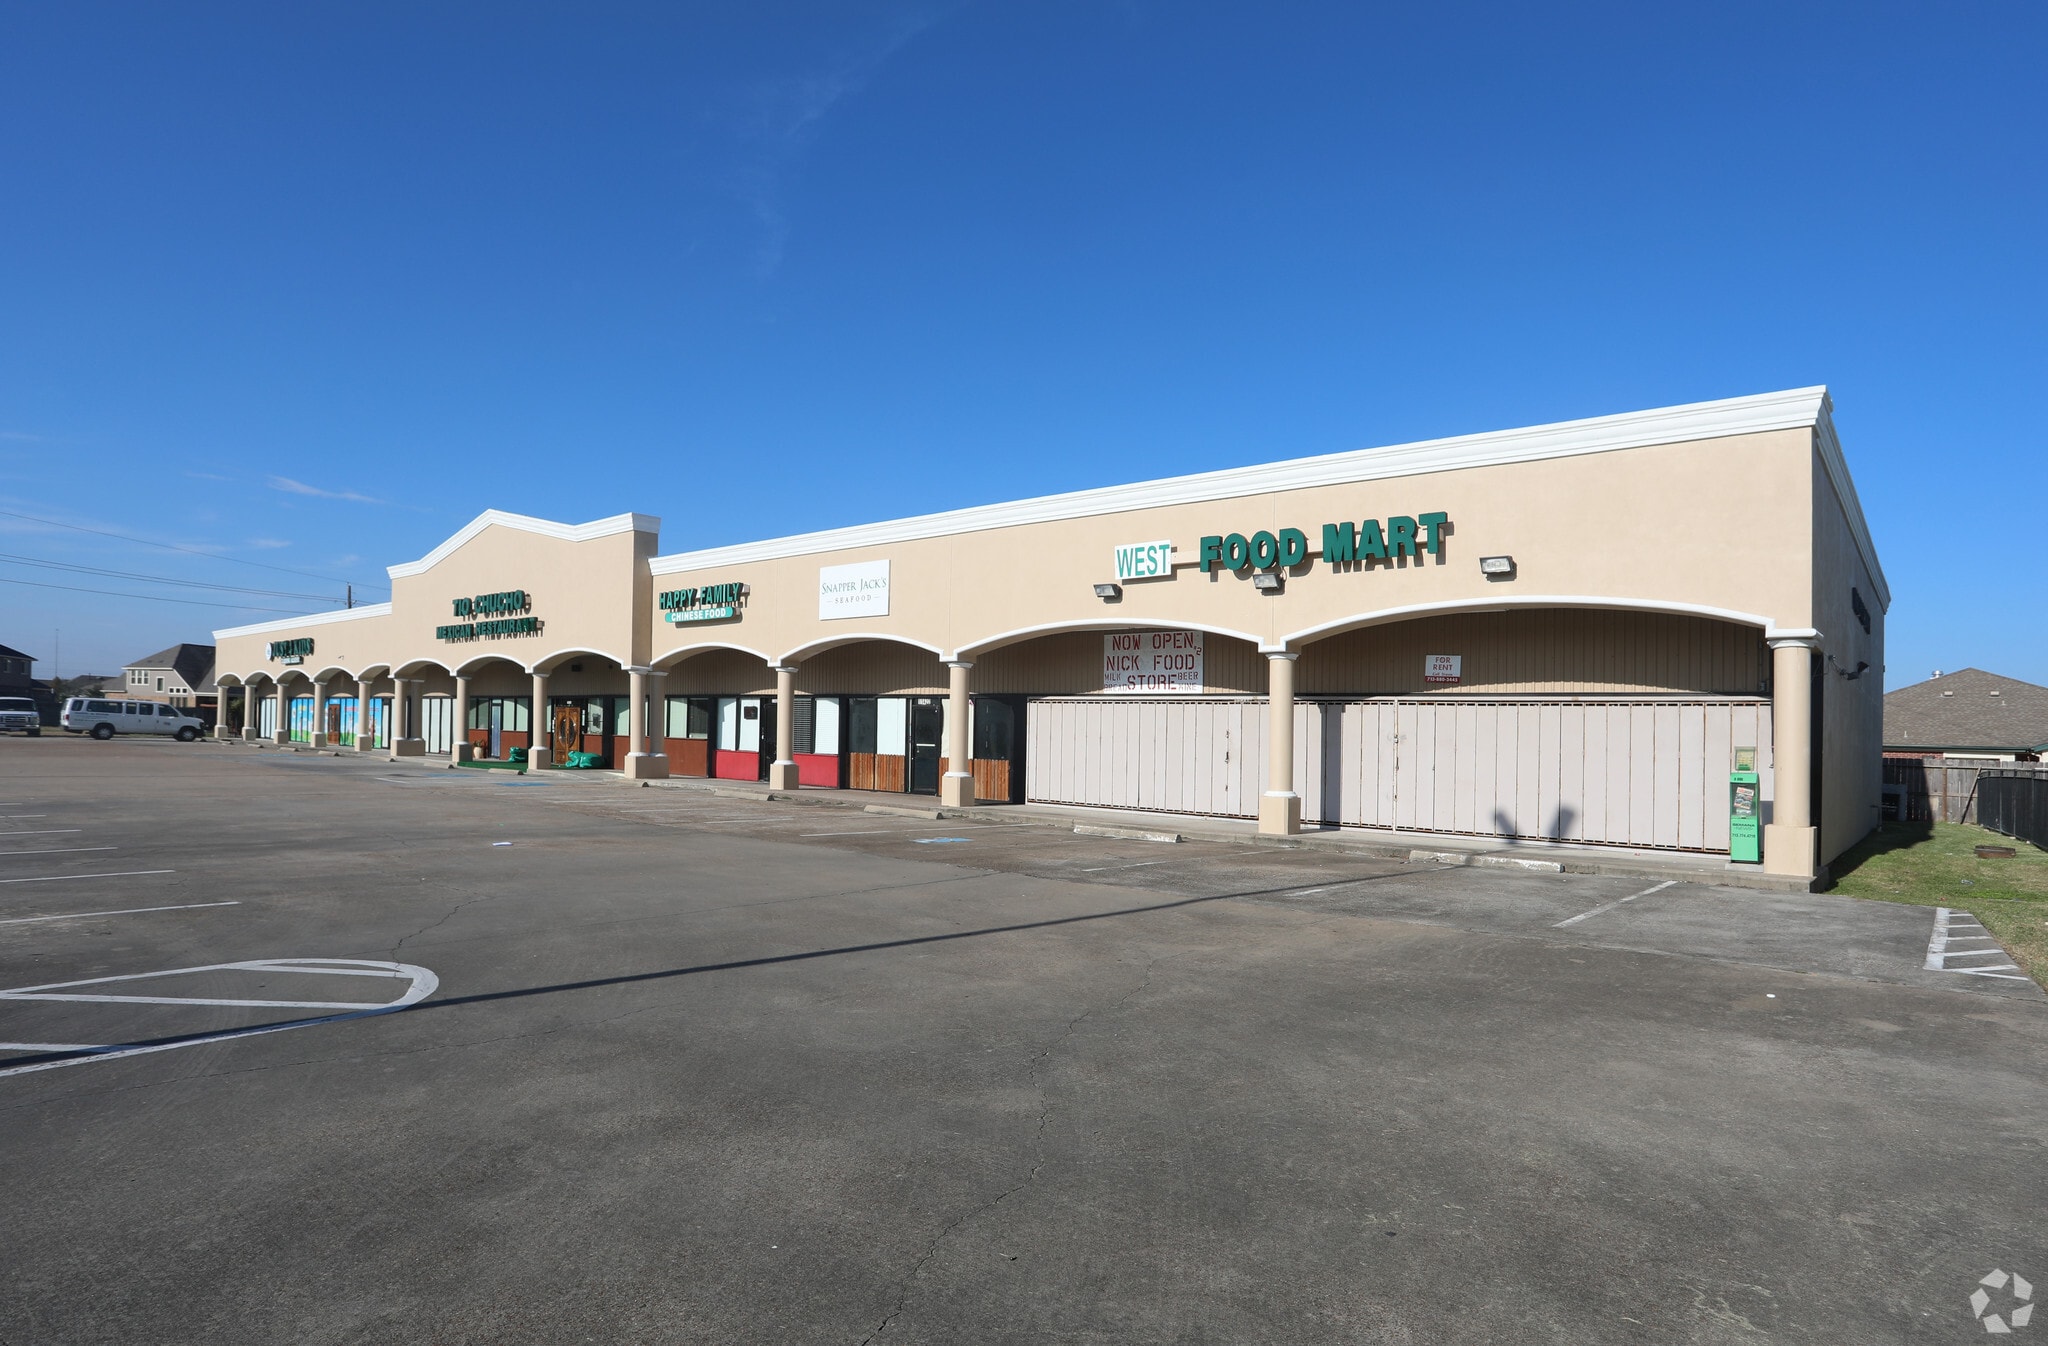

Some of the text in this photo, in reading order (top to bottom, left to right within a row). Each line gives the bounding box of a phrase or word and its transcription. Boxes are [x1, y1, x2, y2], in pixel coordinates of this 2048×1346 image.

[1200, 511, 1448, 573] FOOD MART
[1116, 544, 1171, 577] WEST
[821, 577, 887, 595] SNAPPER JACK'S
[474, 590, 525, 614] CHUCHO
[659, 582, 743, 610] HAPPY FAMILY
[834, 594, 872, 604] SEAFOOD
[671, 607, 726, 622] CHINESE FOOD
[436, 617, 538, 640] MEXICAN RESTAURANT
[1112, 632, 1194, 651] NOW OPEN
[1106, 654, 1195, 671] NICK FOOD
[1432, 663, 1453, 671] RENT
[1435, 656, 1451, 664] FOR
[1104, 673, 1121, 681] MILK
[1127, 674, 1177, 690] STORE
[1177, 671, 1199, 681] BEER
